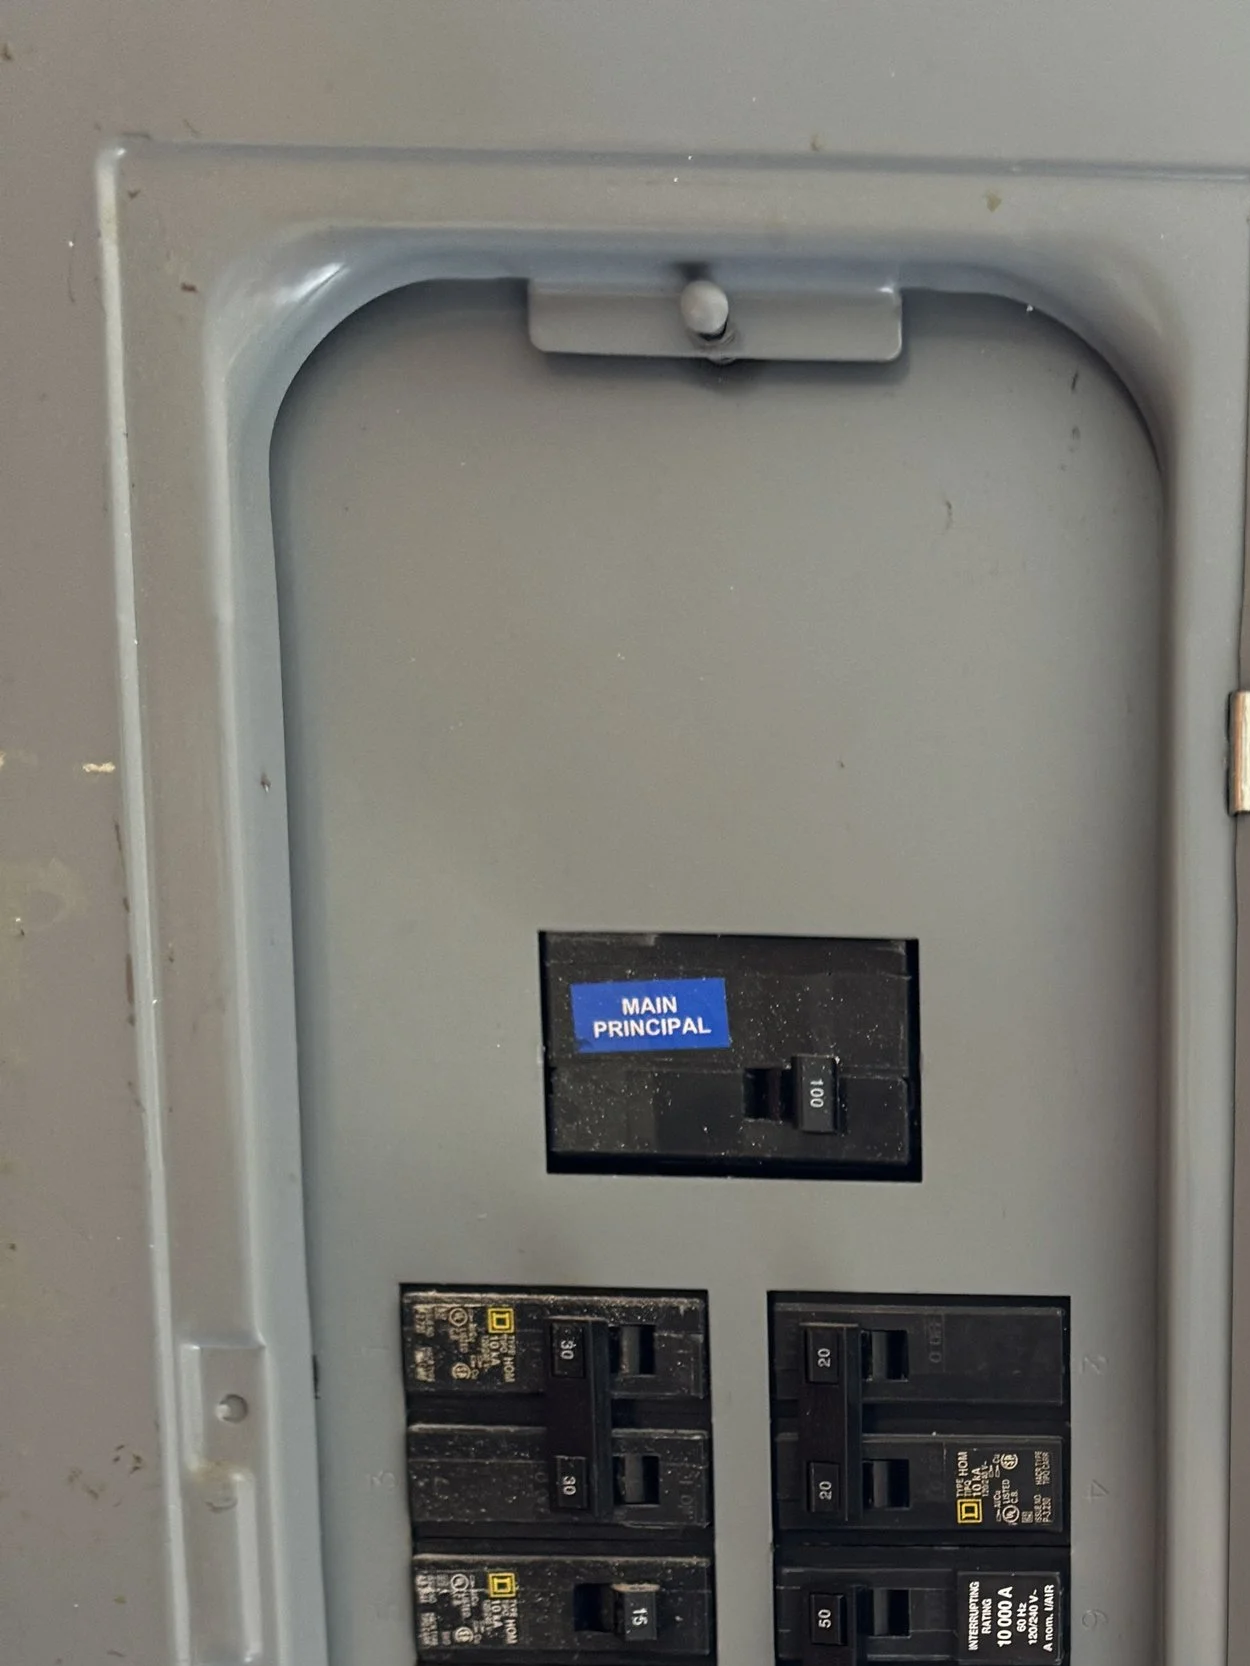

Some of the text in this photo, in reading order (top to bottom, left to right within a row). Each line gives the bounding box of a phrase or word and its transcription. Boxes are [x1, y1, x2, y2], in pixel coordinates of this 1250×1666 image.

[621, 996, 677, 1015] MAIN
[593, 1017, 712, 1039] PRINCIPAL
[809, 1079, 824, 1109] 100
[818, 1347, 831, 1368] 20
[820, 1480, 832, 1500] 20
[631, 1607, 648, 1627] 15
[819, 1608, 831, 1629] 50
[969, 1581, 979, 1650] INTERRUPTING
[983, 1598, 992, 1634] RATING
[998, 1586, 1013, 1647] 10 000 A
